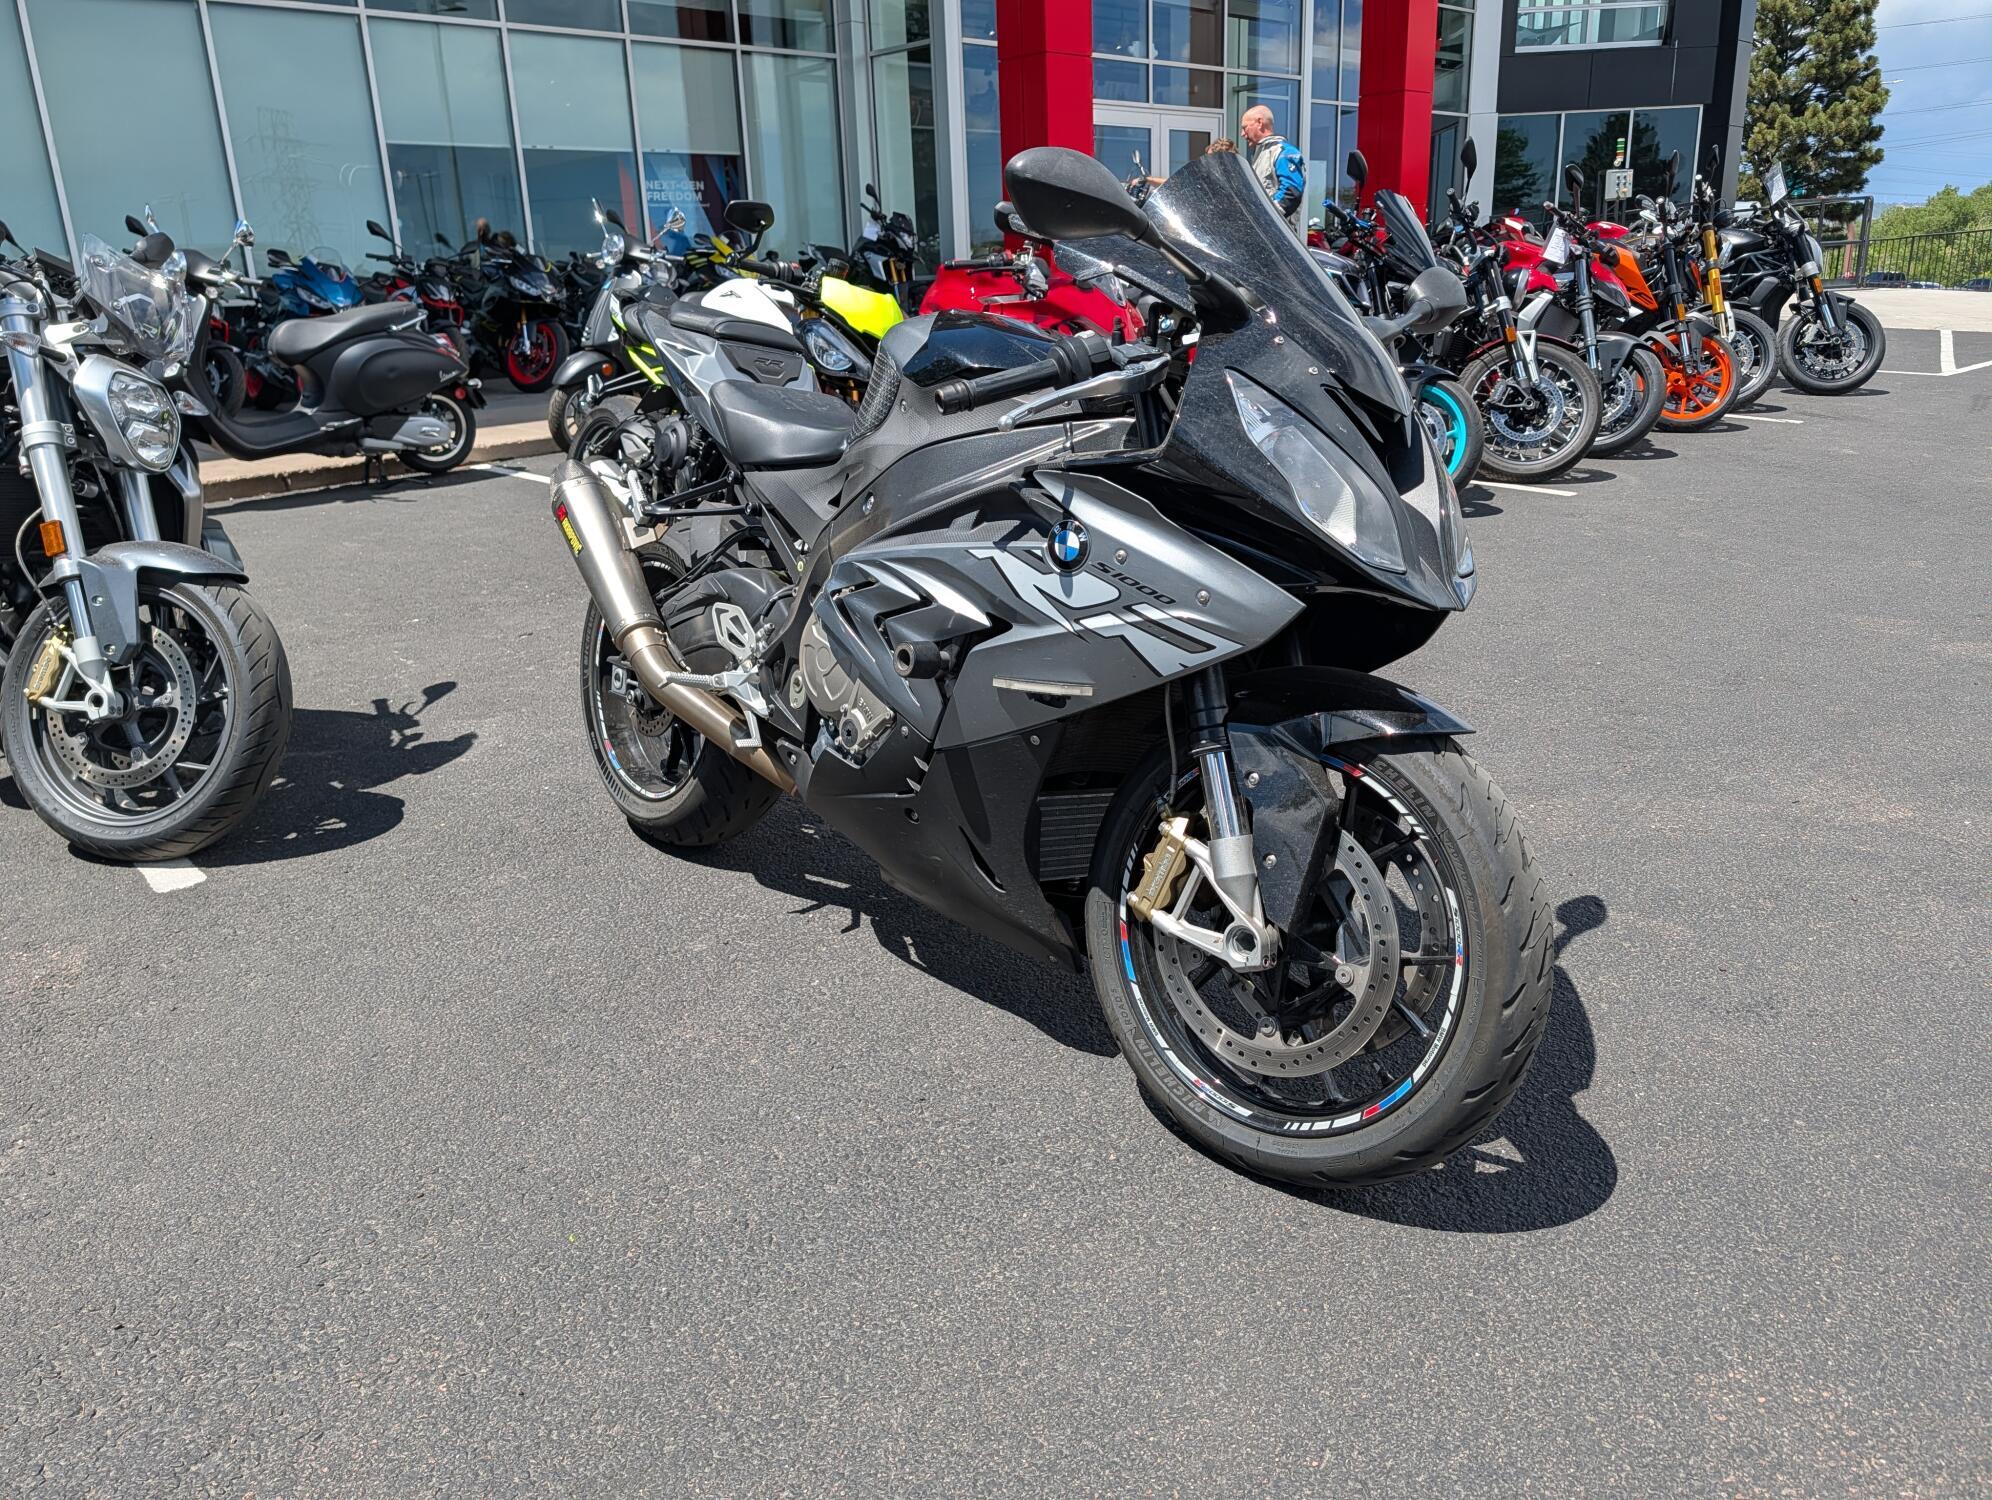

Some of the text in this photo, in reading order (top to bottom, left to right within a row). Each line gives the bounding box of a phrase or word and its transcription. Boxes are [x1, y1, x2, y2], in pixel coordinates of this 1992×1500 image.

[646, 180, 705, 191] NEXT-GEN
[647, 191, 703, 201] FREEDOM
[1054, 521, 1089, 542] BMW
[1089, 561, 1177, 605] S1000
[1373, 759, 1437, 819] CHELIN
[1451, 906, 1464, 967] S1000RR
[1114, 996, 1133, 1027] ROAD
[1422, 1026, 1447, 1069] BMW Motorrad
[1135, 1037, 1204, 1117] MICHELIN
